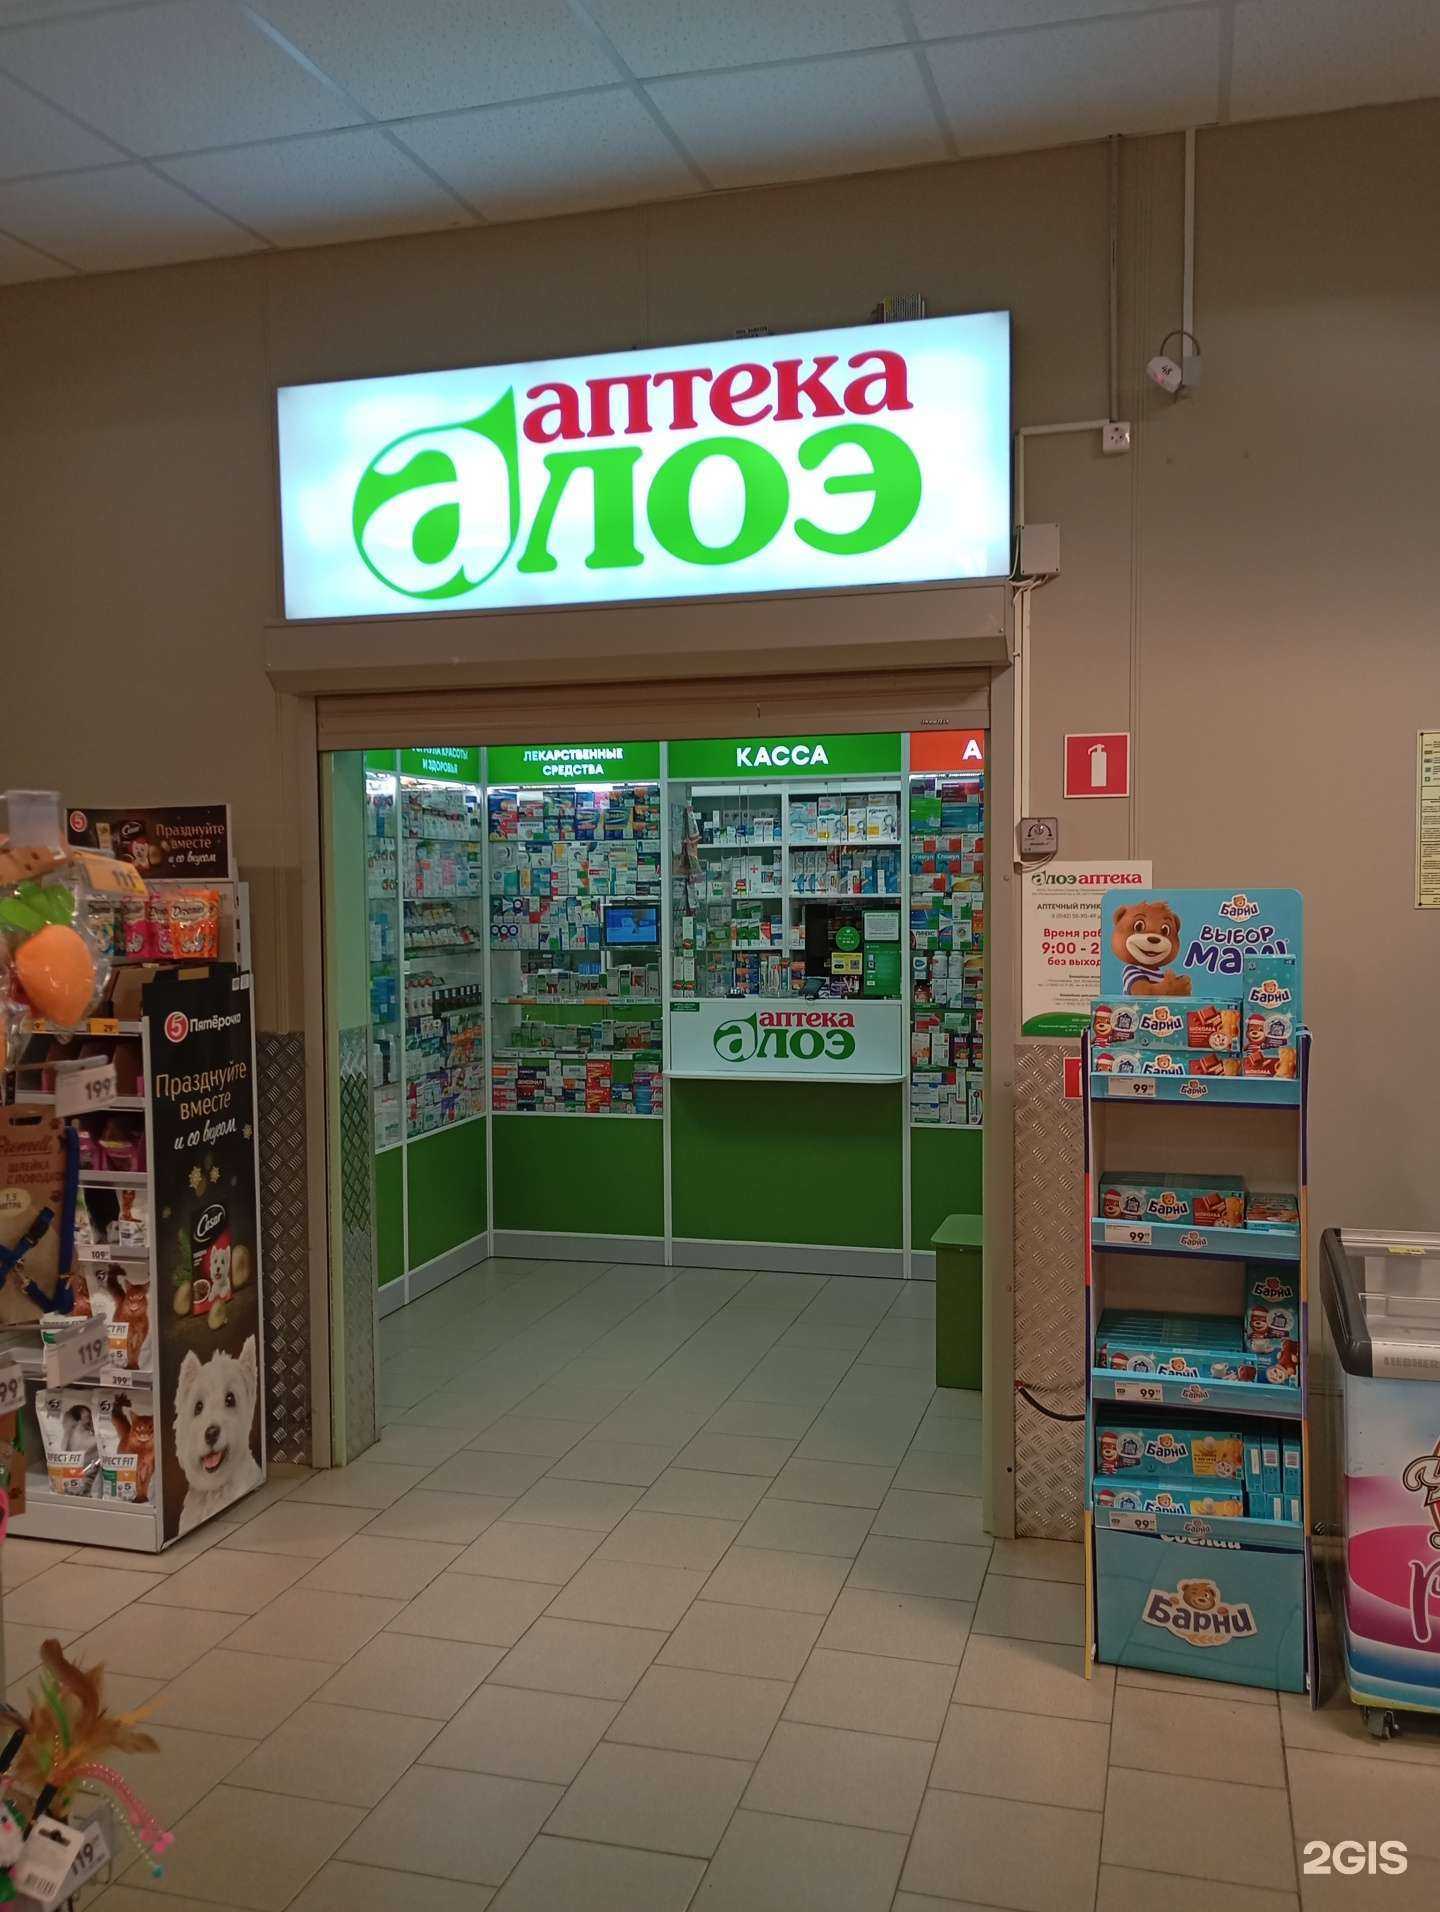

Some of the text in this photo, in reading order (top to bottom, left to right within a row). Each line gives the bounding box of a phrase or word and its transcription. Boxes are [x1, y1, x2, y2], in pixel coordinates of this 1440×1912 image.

[523, 348, 914, 444] аптека
[523, 747, 624, 762] ЛЕКАРСТВЕННЫЕ
[736, 744, 829, 767] КАССА
[962, 739, 983, 760] А
[542, 763, 605, 777] СРЕДСТВА
[156, 823, 225, 839] Празднуйте
[171, 838, 212, 849] вместе
[1037, 903, 1079, 911] АПТЕЧНЫЙ
[1220, 903, 1259, 917] Барни
[1043, 928, 1080, 940] Время
[1042, 942, 1076, 954] 9:00
[1090, 942, 1100, 954] 2
[1047, 957, 1066, 966] без
[1250, 989, 1290, 1004] Барни
[759, 1011, 855, 1028] аптека
[1141, 1014, 1183, 1031] Барни
[156, 1060, 247, 1101] Празднуйте
[1132, 1083, 1148, 1093] 99
[1181, 1085, 1207, 1096] Барни
[180, 1091, 231, 1120] вместе
[187, 1130, 200, 1147] со
[203, 1117, 238, 1146] вкусом
[1148, 1201, 1189, 1216] Барни
[1129, 1231, 1145, 1241] 99
[1180, 1237, 1207, 1247] Барни
[1254, 1281, 1293, 1299] Барни
[1140, 1388, 1156, 1398] 99
[1146, 1443, 1188, 1459] Барни
[1134, 1519, 1150, 1529] 99
[1147, 1593, 1252, 1634] Барни
